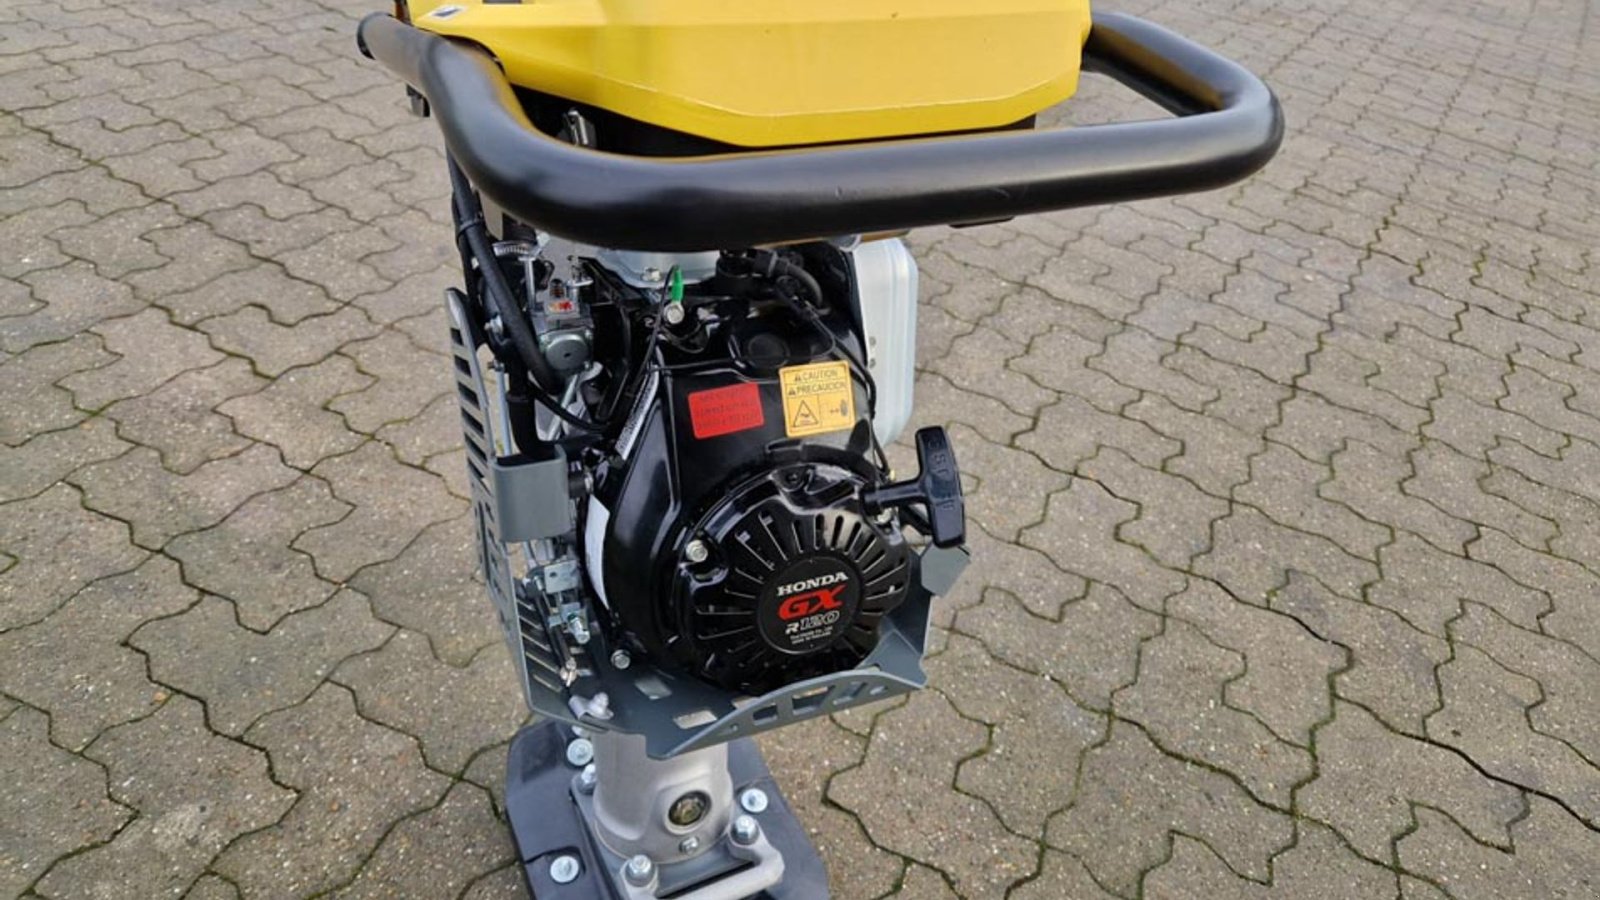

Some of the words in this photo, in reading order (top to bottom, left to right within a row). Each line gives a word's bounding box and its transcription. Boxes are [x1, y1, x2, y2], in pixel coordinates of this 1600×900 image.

[802, 369, 838, 380] CAUTION
[777, 571, 848, 596] HONDA
[778, 583, 848, 620] GX
